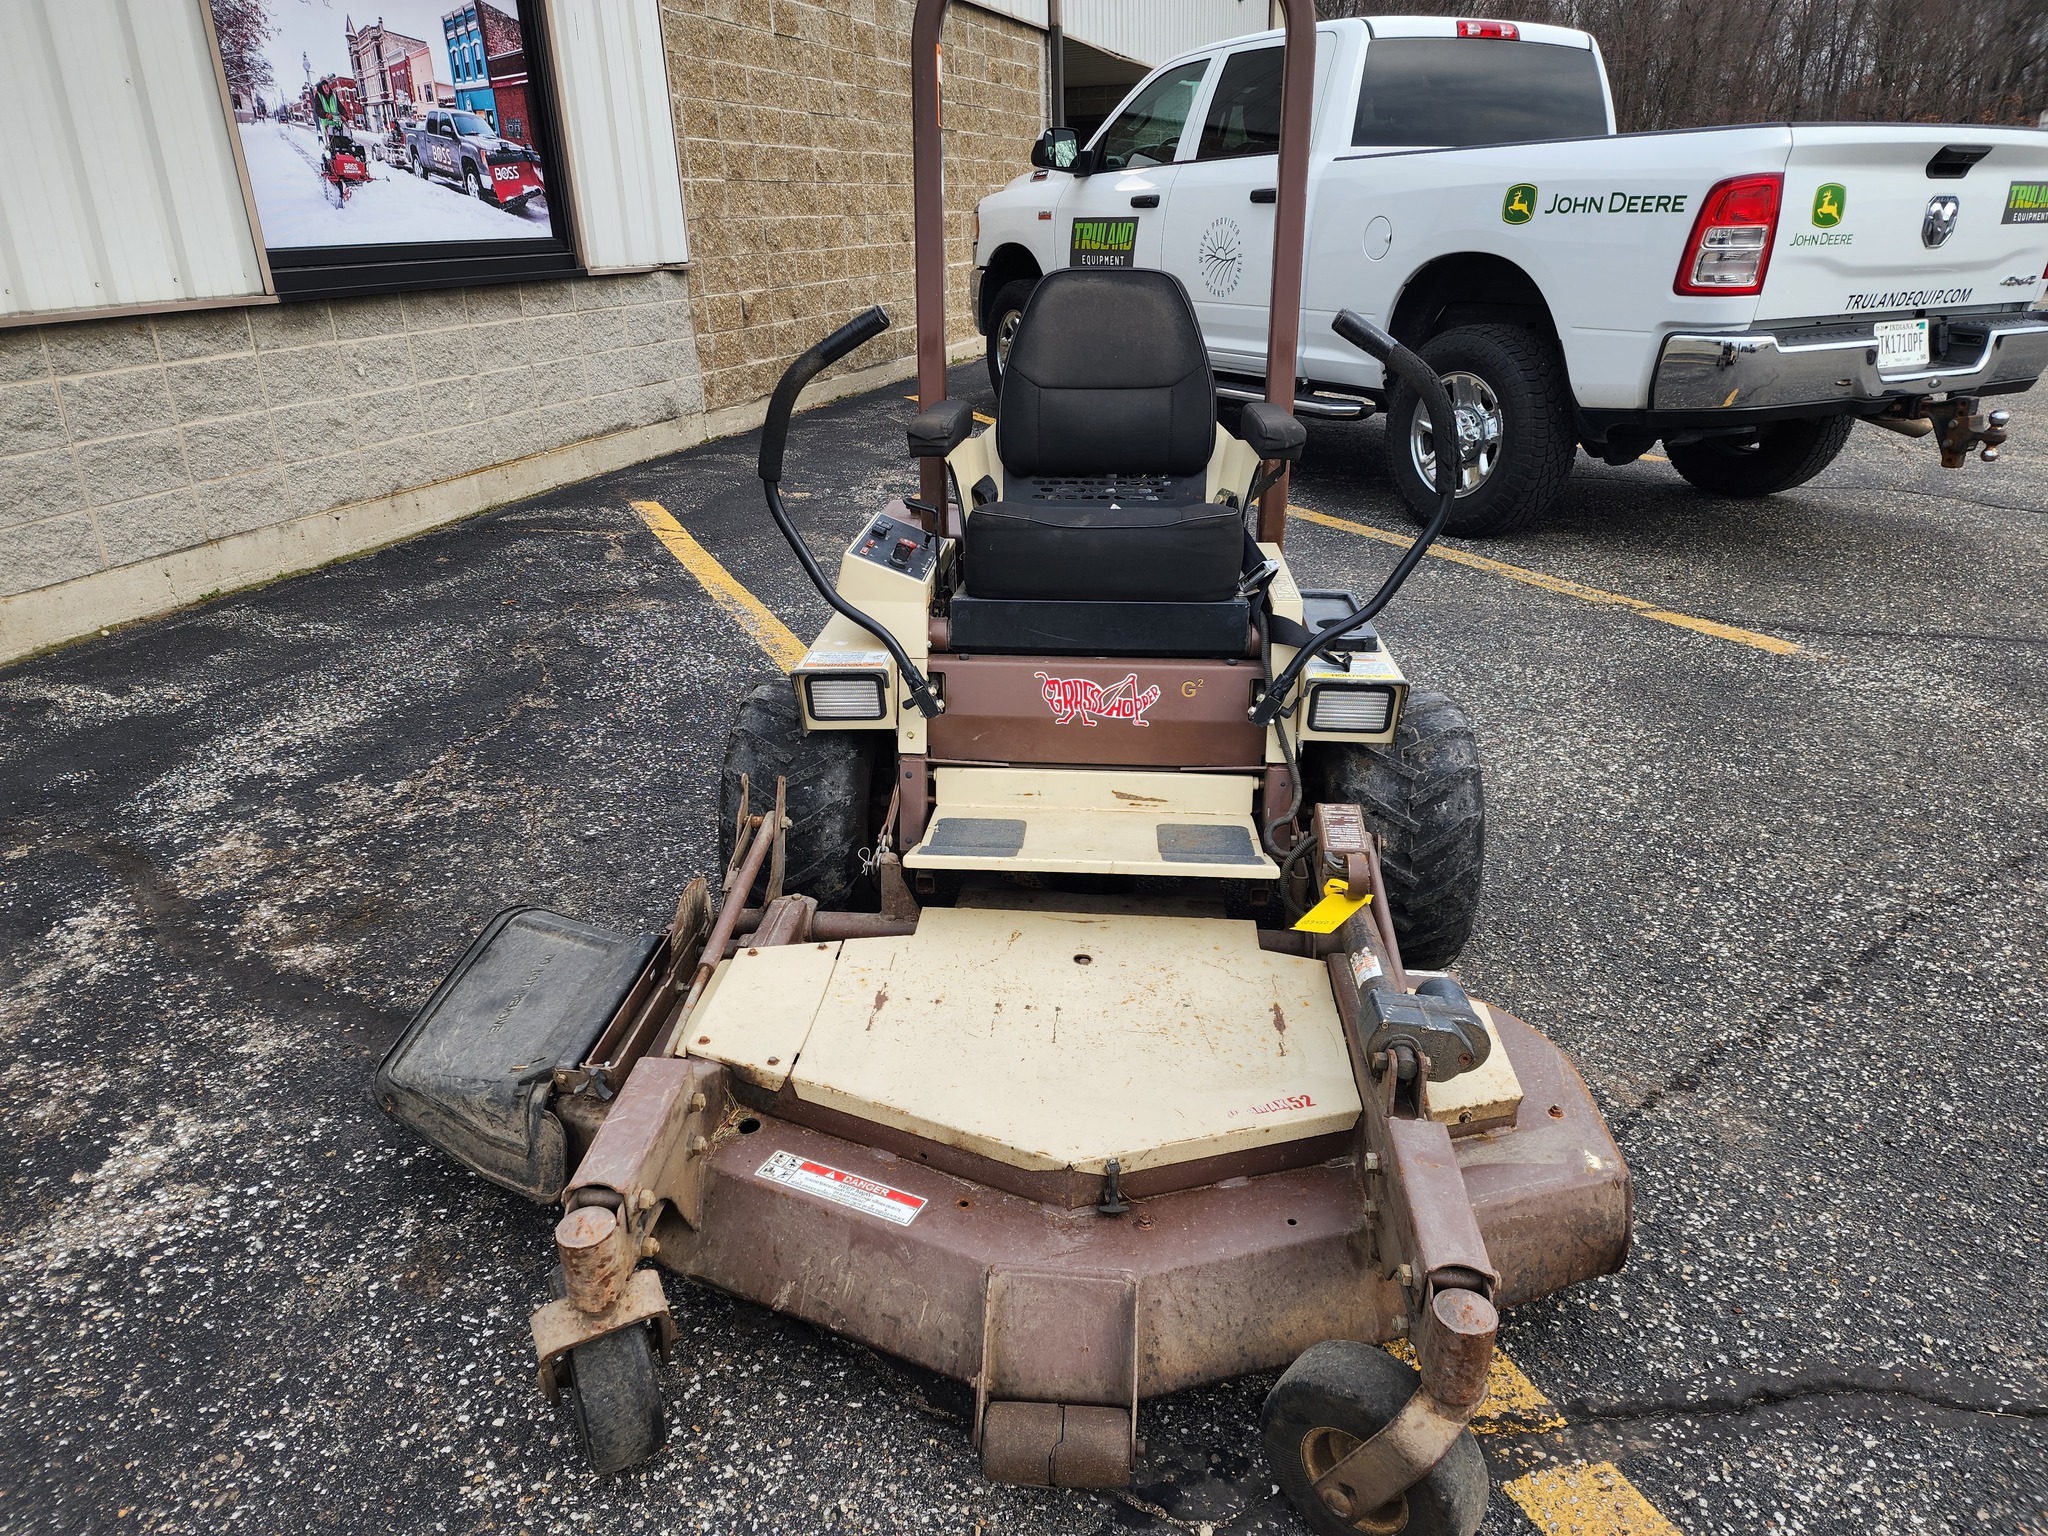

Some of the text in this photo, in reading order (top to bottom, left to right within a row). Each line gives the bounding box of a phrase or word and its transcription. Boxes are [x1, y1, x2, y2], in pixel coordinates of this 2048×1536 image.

[432, 145, 452, 165] BOSS
[495, 166, 519, 180] BOSS
[1545, 192, 1687, 214] JOHN DEERE
[1074, 222, 1135, 250] TRULAND
[1199, 217, 1240, 264] WHERE PROVIDER
[1790, 233, 1853, 246] JOHN DEERE
[1081, 255, 1125, 266] EQUIPMENT
[1205, 253, 1242, 298] MEANS PARTNER
[1845, 288, 1973, 310] TRULANDEQUIP.COM
[1889, 323, 1914, 331] INDIANA
[1041, 674, 1161, 722] GRASSHOPPER
[1287, 1094, 1317, 1109] 52
[838, 1184, 855, 1192] KEEP
[841, 1175, 890, 1196] DANGER
